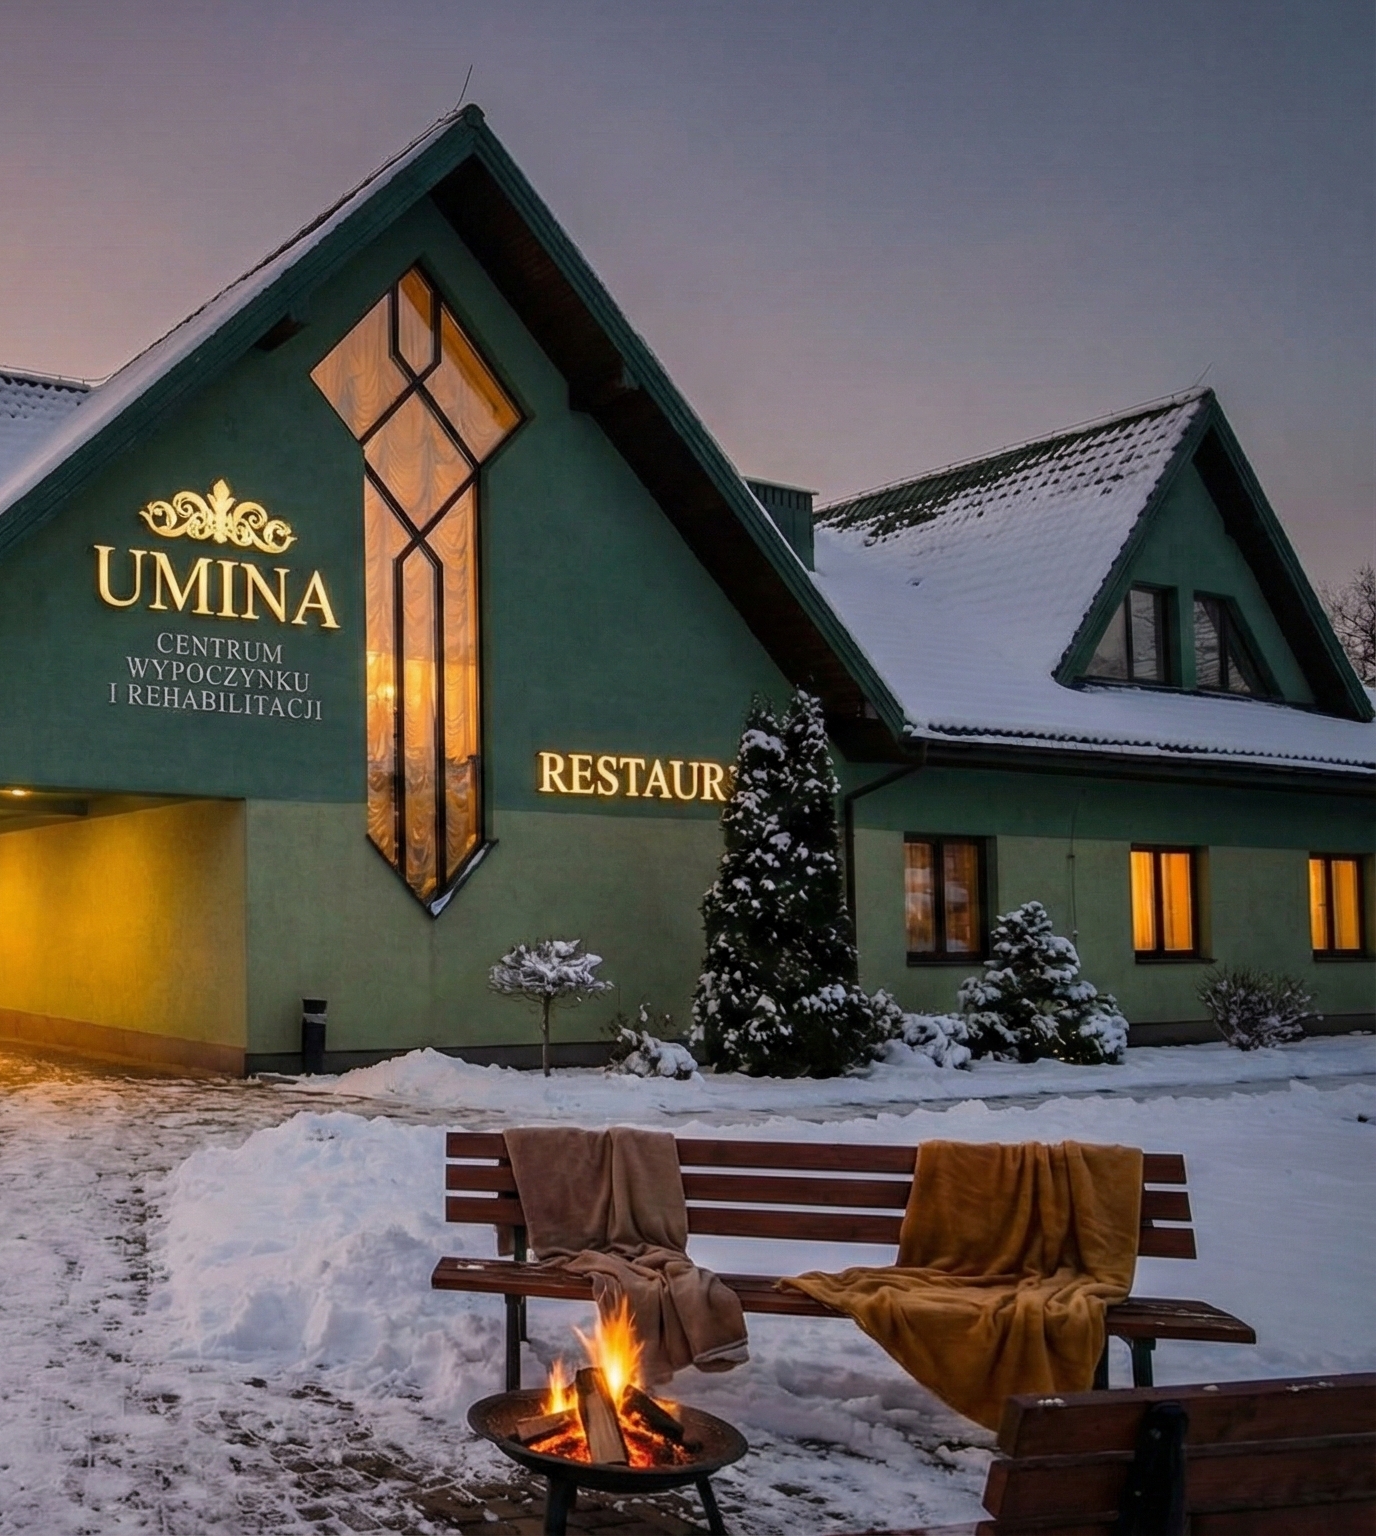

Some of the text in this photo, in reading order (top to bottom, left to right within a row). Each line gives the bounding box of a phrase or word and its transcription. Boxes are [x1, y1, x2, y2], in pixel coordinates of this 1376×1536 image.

[93, 544, 341, 629] UMINA
[156, 632, 283, 664] CENTRUM
[126, 656, 310, 693] WYPOCZYNKU
[108, 682, 323, 721] I REHABILITACJI
[538, 751, 728, 801] RESTAUR
